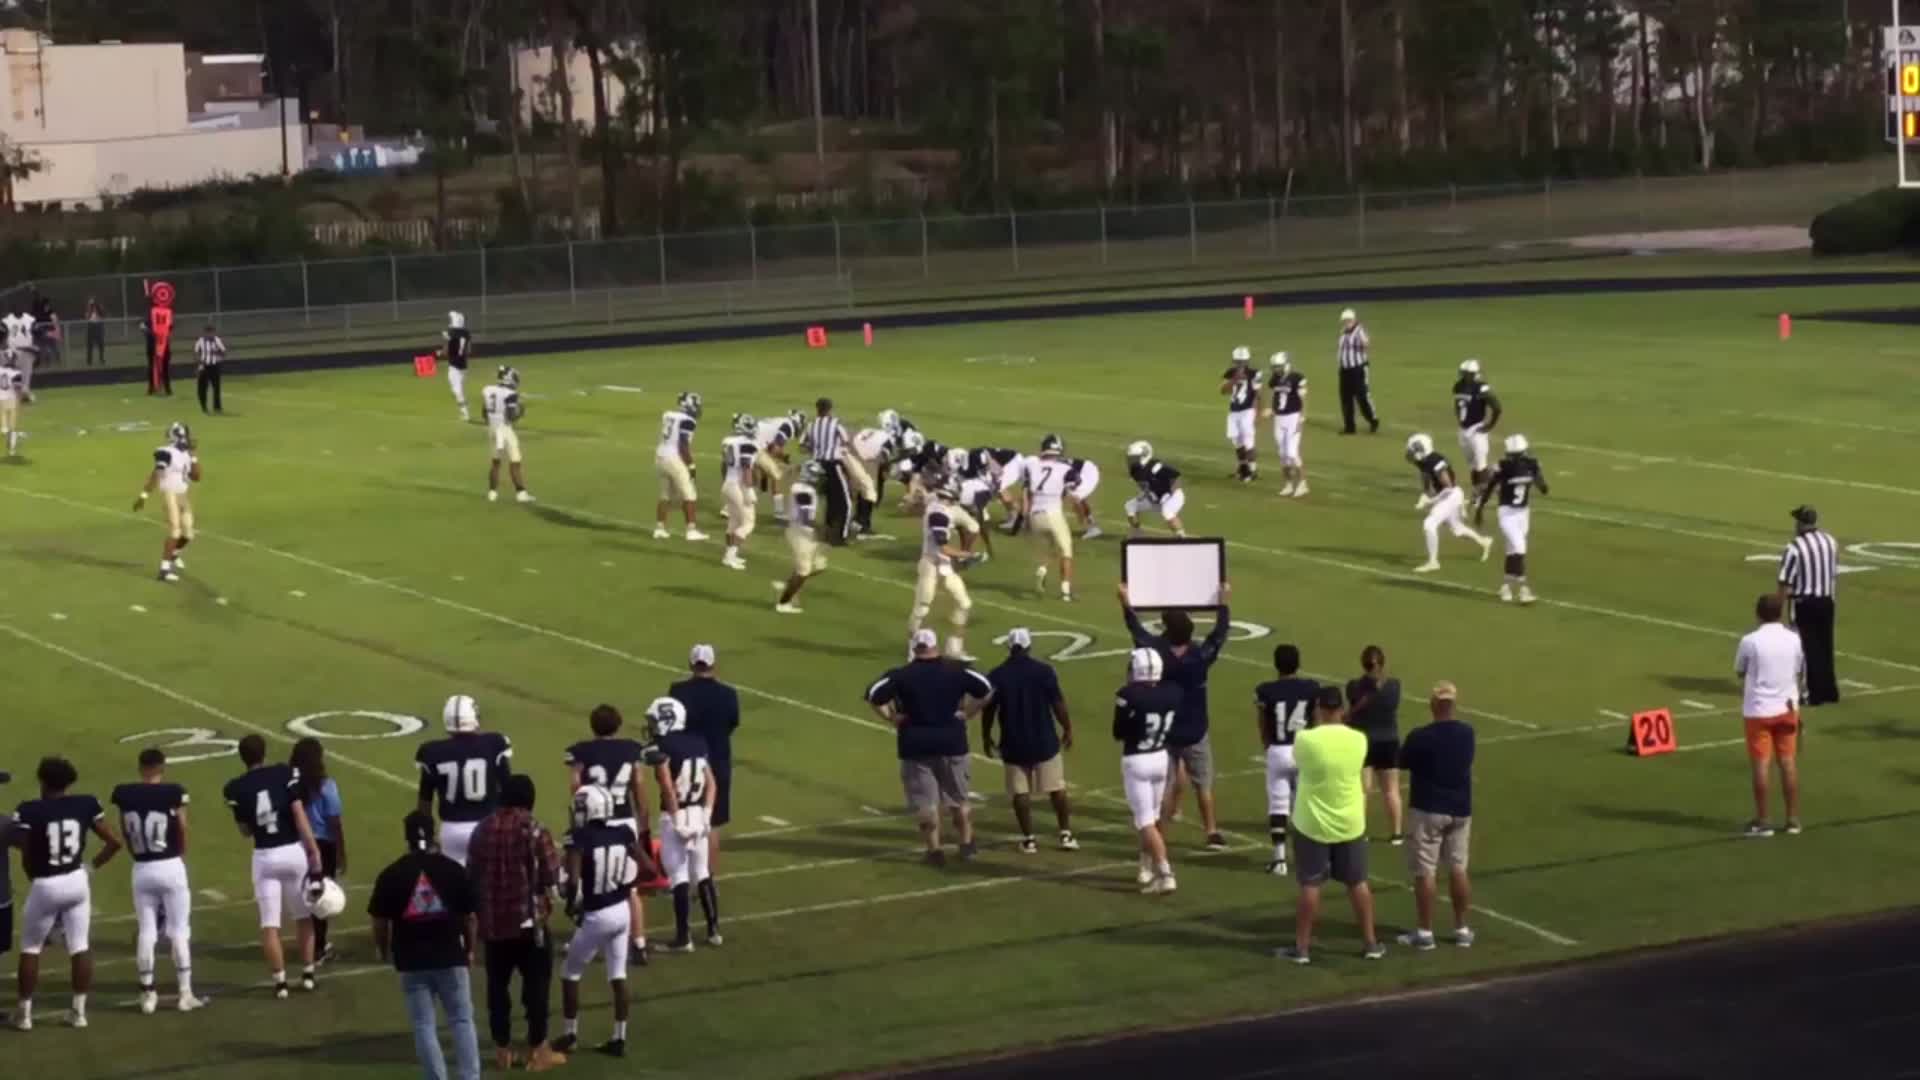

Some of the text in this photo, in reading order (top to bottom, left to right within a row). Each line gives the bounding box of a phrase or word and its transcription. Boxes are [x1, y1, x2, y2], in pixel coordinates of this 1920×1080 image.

[1037, 467, 1053, 491] 7
[1138, 711, 1175, 750] 31
[1274, 700, 1308, 741] 14
[1639, 714, 1670, 748] 20
[436, 758, 487, 804] 70
[256, 789, 278, 834] 4
[47, 818, 81, 867] 13
[593, 844, 628, 894] 10
